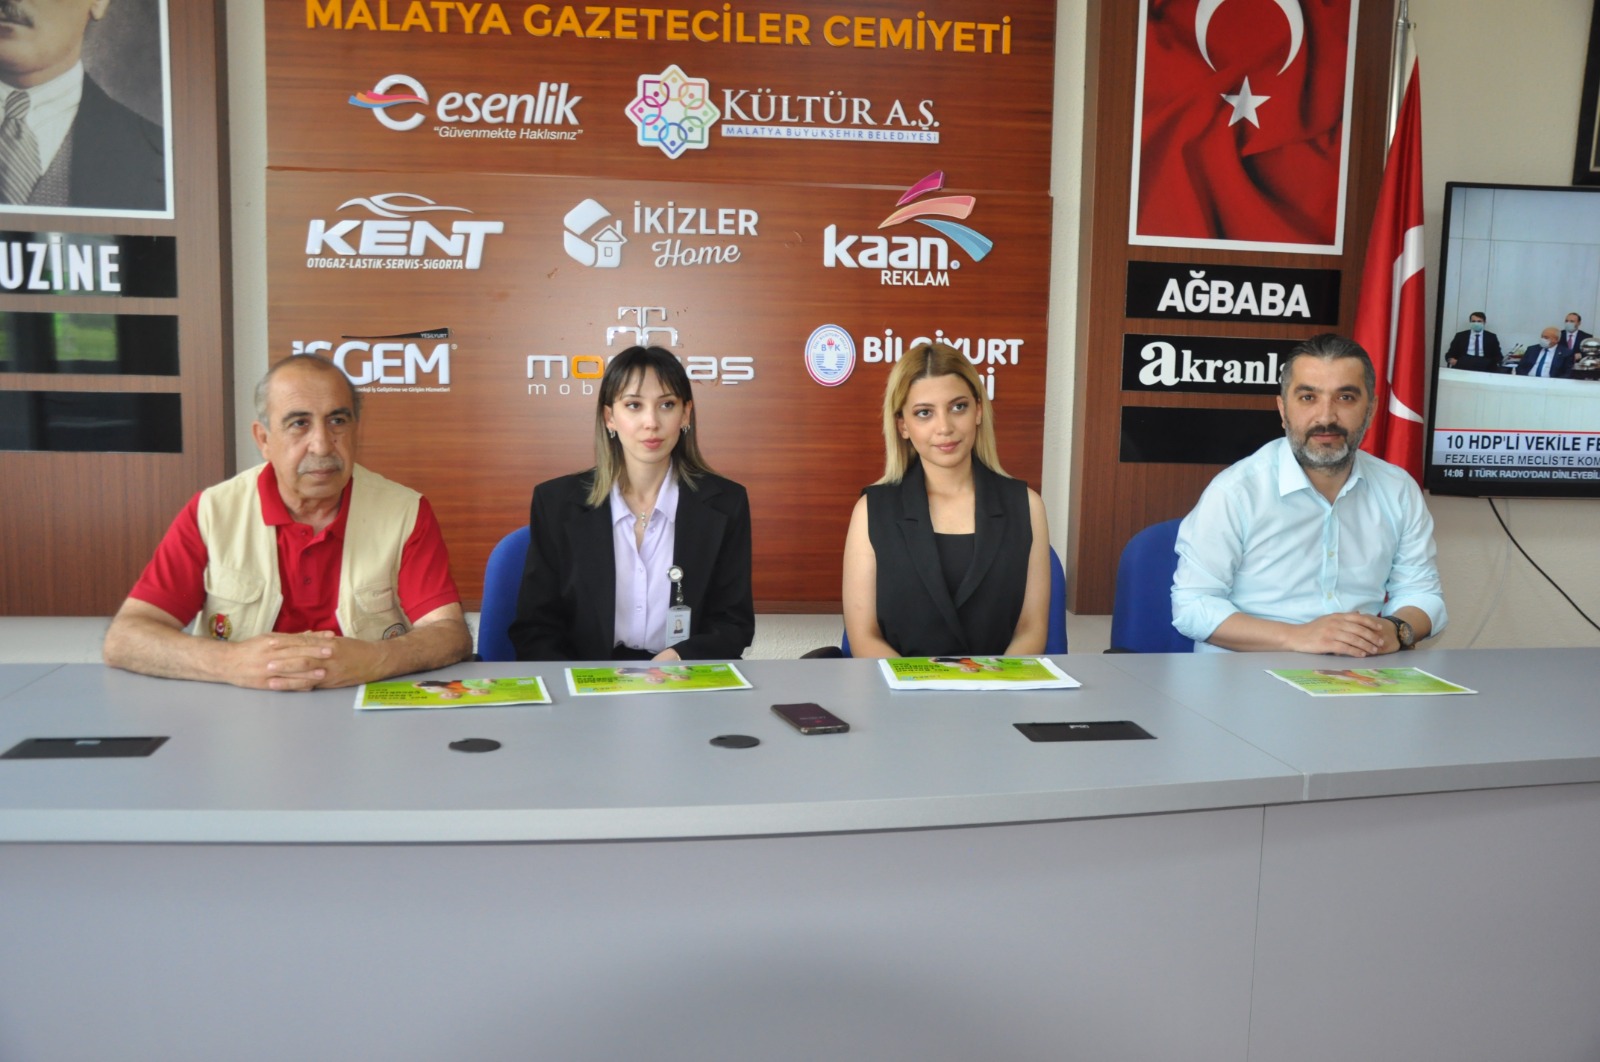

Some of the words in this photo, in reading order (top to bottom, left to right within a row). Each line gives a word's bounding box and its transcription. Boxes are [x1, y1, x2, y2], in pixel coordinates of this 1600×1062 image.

[306, 0, 511, 35] MALATYA
[523, 3, 811, 46] GAZETECİLER
[823, 11, 1011, 54] CEMİYETİ
[436, 81, 583, 126] esenlik
[721, 87, 878, 125] KÜLTÜR
[884, 98, 940, 131] A.Ş.
[725, 127, 782, 136] MALATYA
[867, 130, 938, 142] BELEDİYESİ
[634, 200, 759, 237] İKİZLER
[305, 219, 504, 270] KENT
[651, 238, 742, 269] Home
[823, 223, 949, 271] kaan
[881, 269, 950, 287] REKLAM
[1156, 269, 1312, 318] AĞBABA
[291, 340, 450, 388] GEM
[1138, 341, 1288, 387] akranl
[1445, 453, 1514, 465] FEZLEKELER
[1446, 434, 1464, 450] 10
[1469, 434, 1520, 451] HDP'Lİ
[1525, 434, 1582, 452] VEKİLE
[1474, 467, 1498, 478] TÜRK
[1499, 469, 1551, 479] RADYO'DAN
